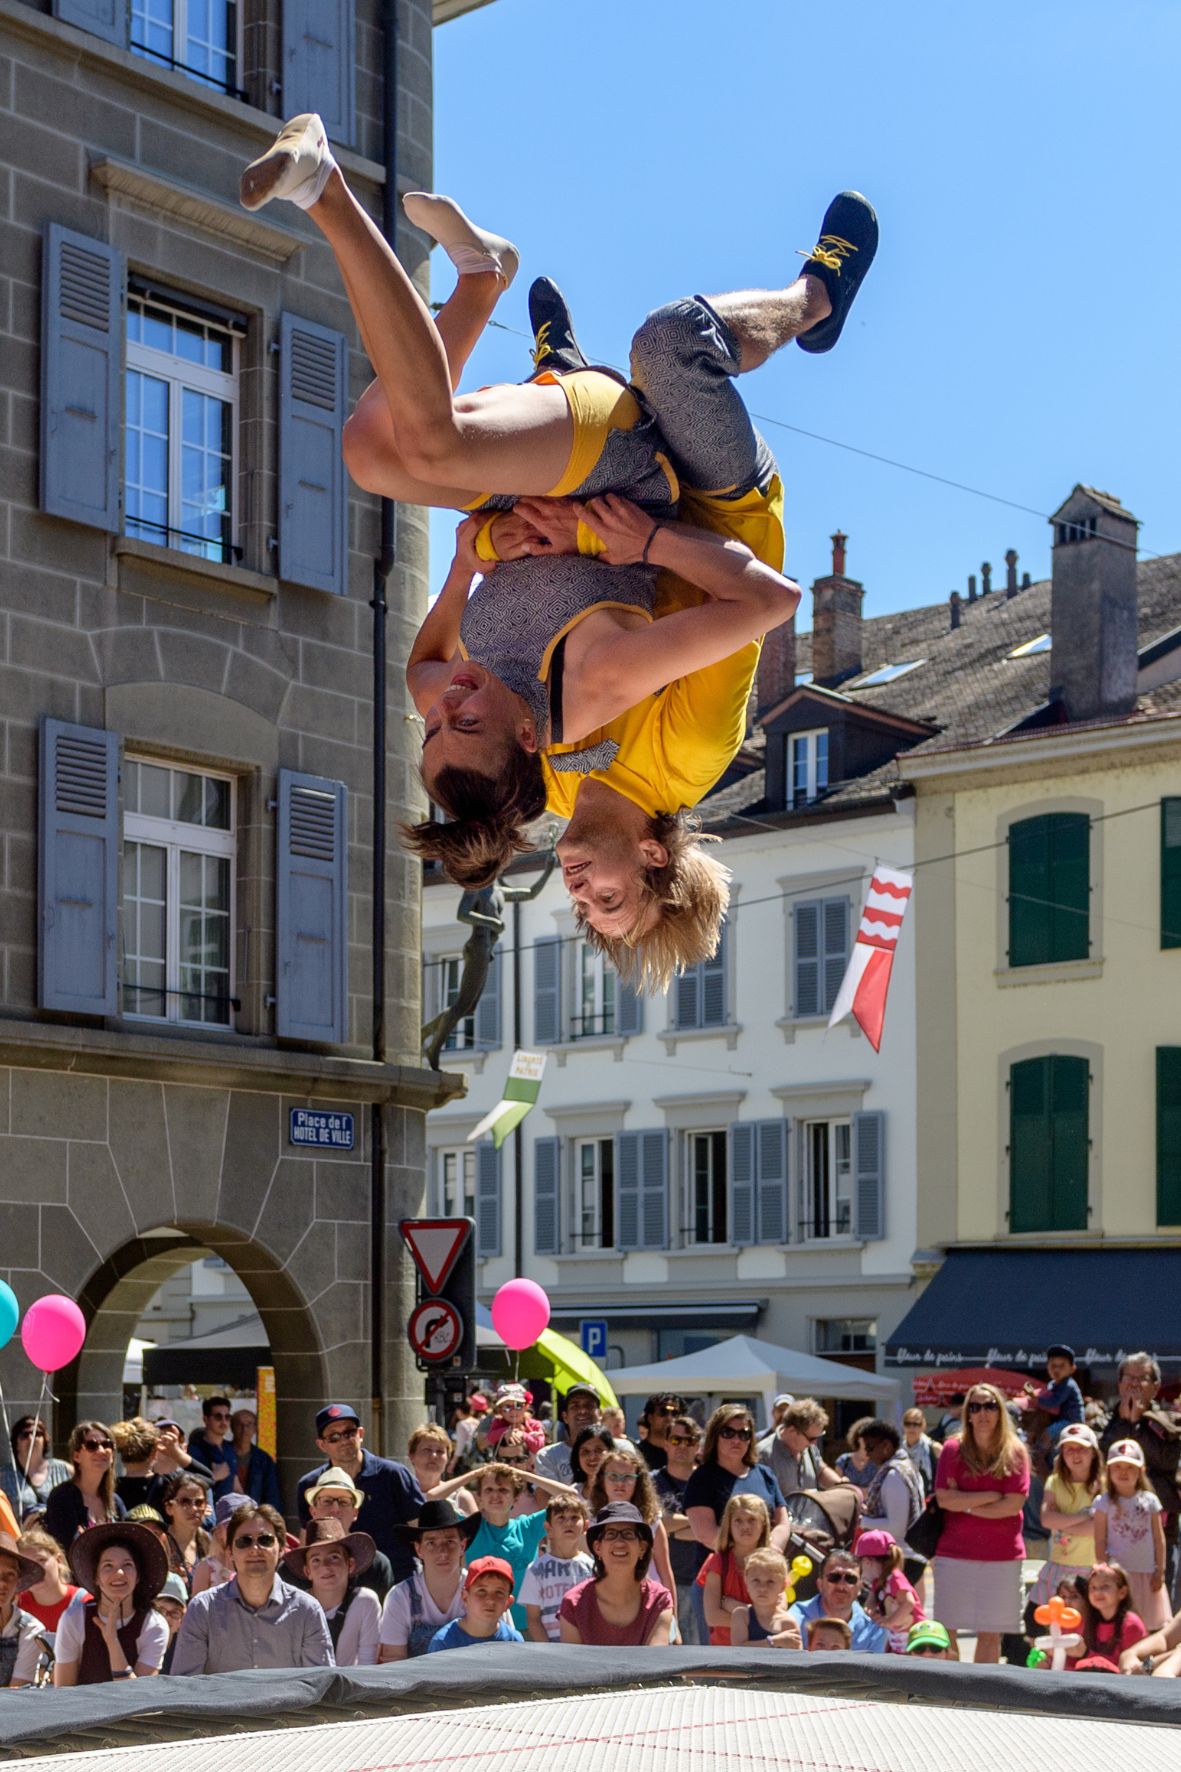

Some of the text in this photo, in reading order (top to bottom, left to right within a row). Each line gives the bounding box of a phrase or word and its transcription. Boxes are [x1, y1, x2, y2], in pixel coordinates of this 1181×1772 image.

[297, 1112, 326, 1128] Place
[328, 1115, 340, 1129] de
[294, 1126, 351, 1145] HOTEL DE VILLE
[588, 1327, 601, 1354] P
[923, 1348, 935, 1361] de
[1015, 1349, 1027, 1362] de
